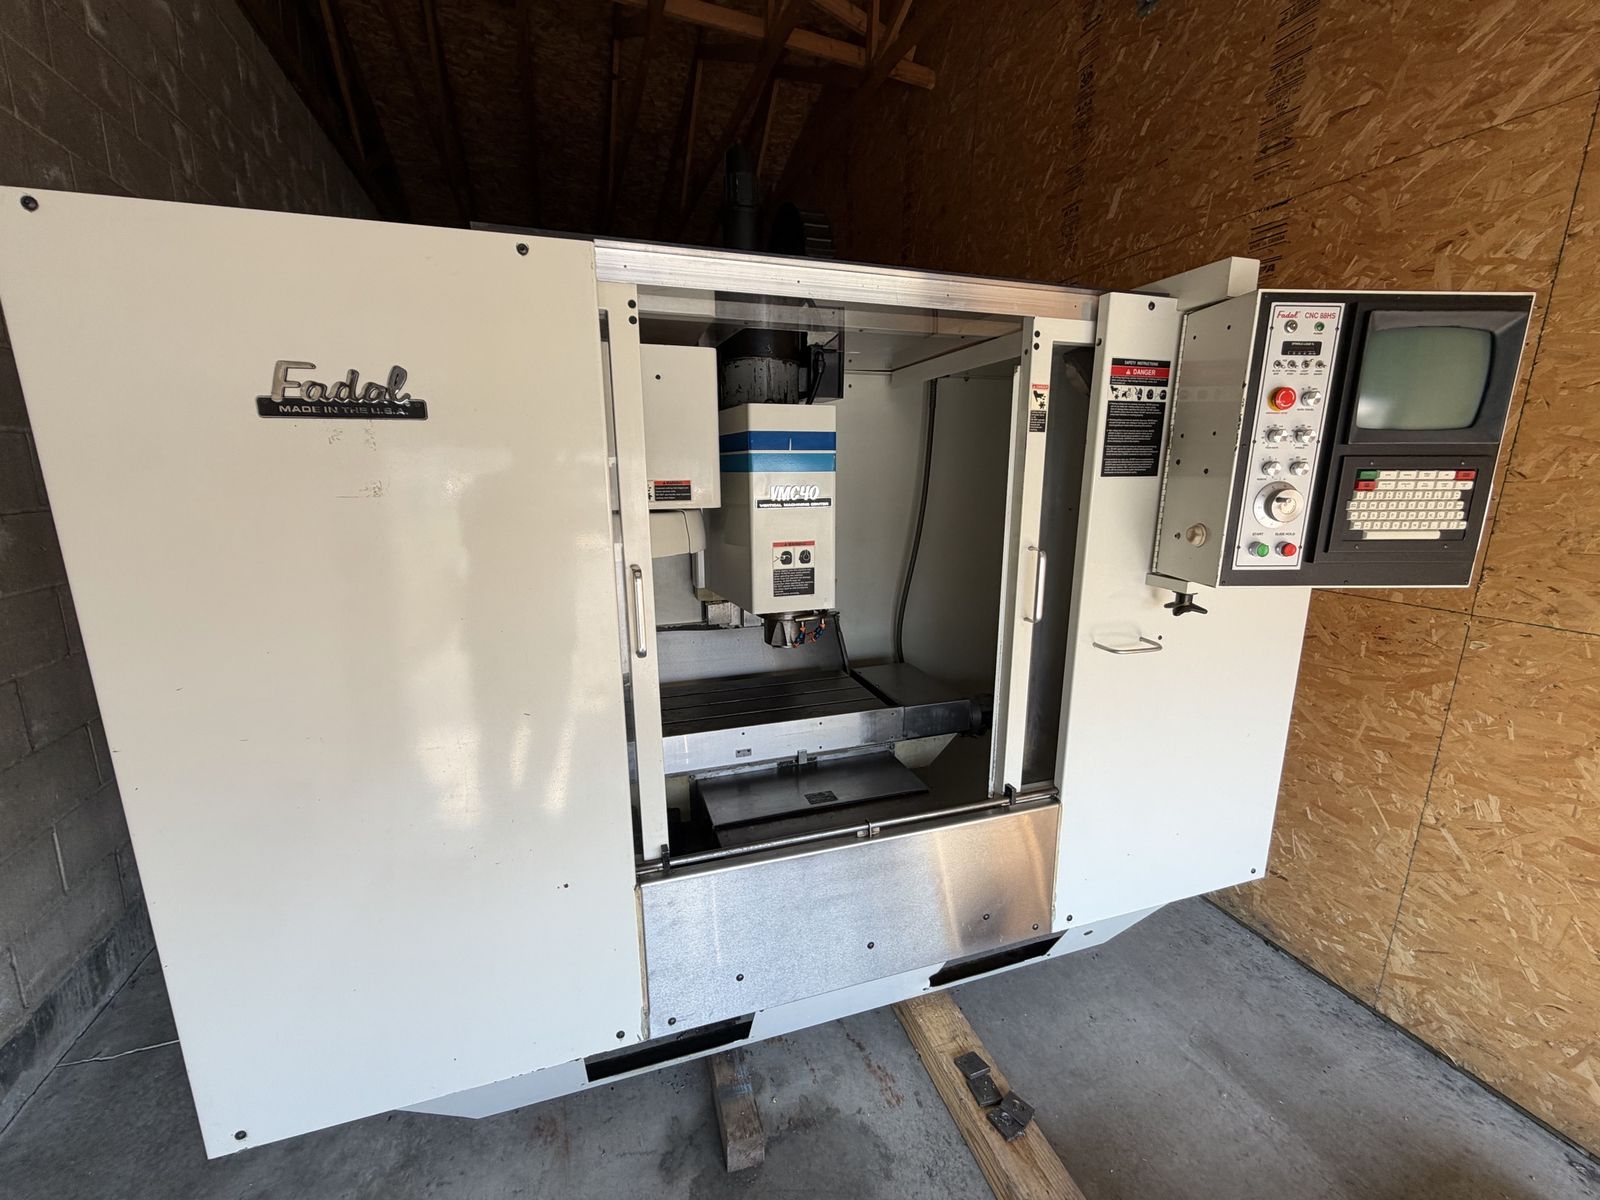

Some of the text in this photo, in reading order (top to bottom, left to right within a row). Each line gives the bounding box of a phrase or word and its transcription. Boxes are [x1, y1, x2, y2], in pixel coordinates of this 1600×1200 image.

[271, 360, 411, 402] Fadal
[278, 405, 320, 413] MADE
[324, 405, 338, 414] IN
[341, 406, 368, 414] THE
[770, 485, 819, 501] VMC40
